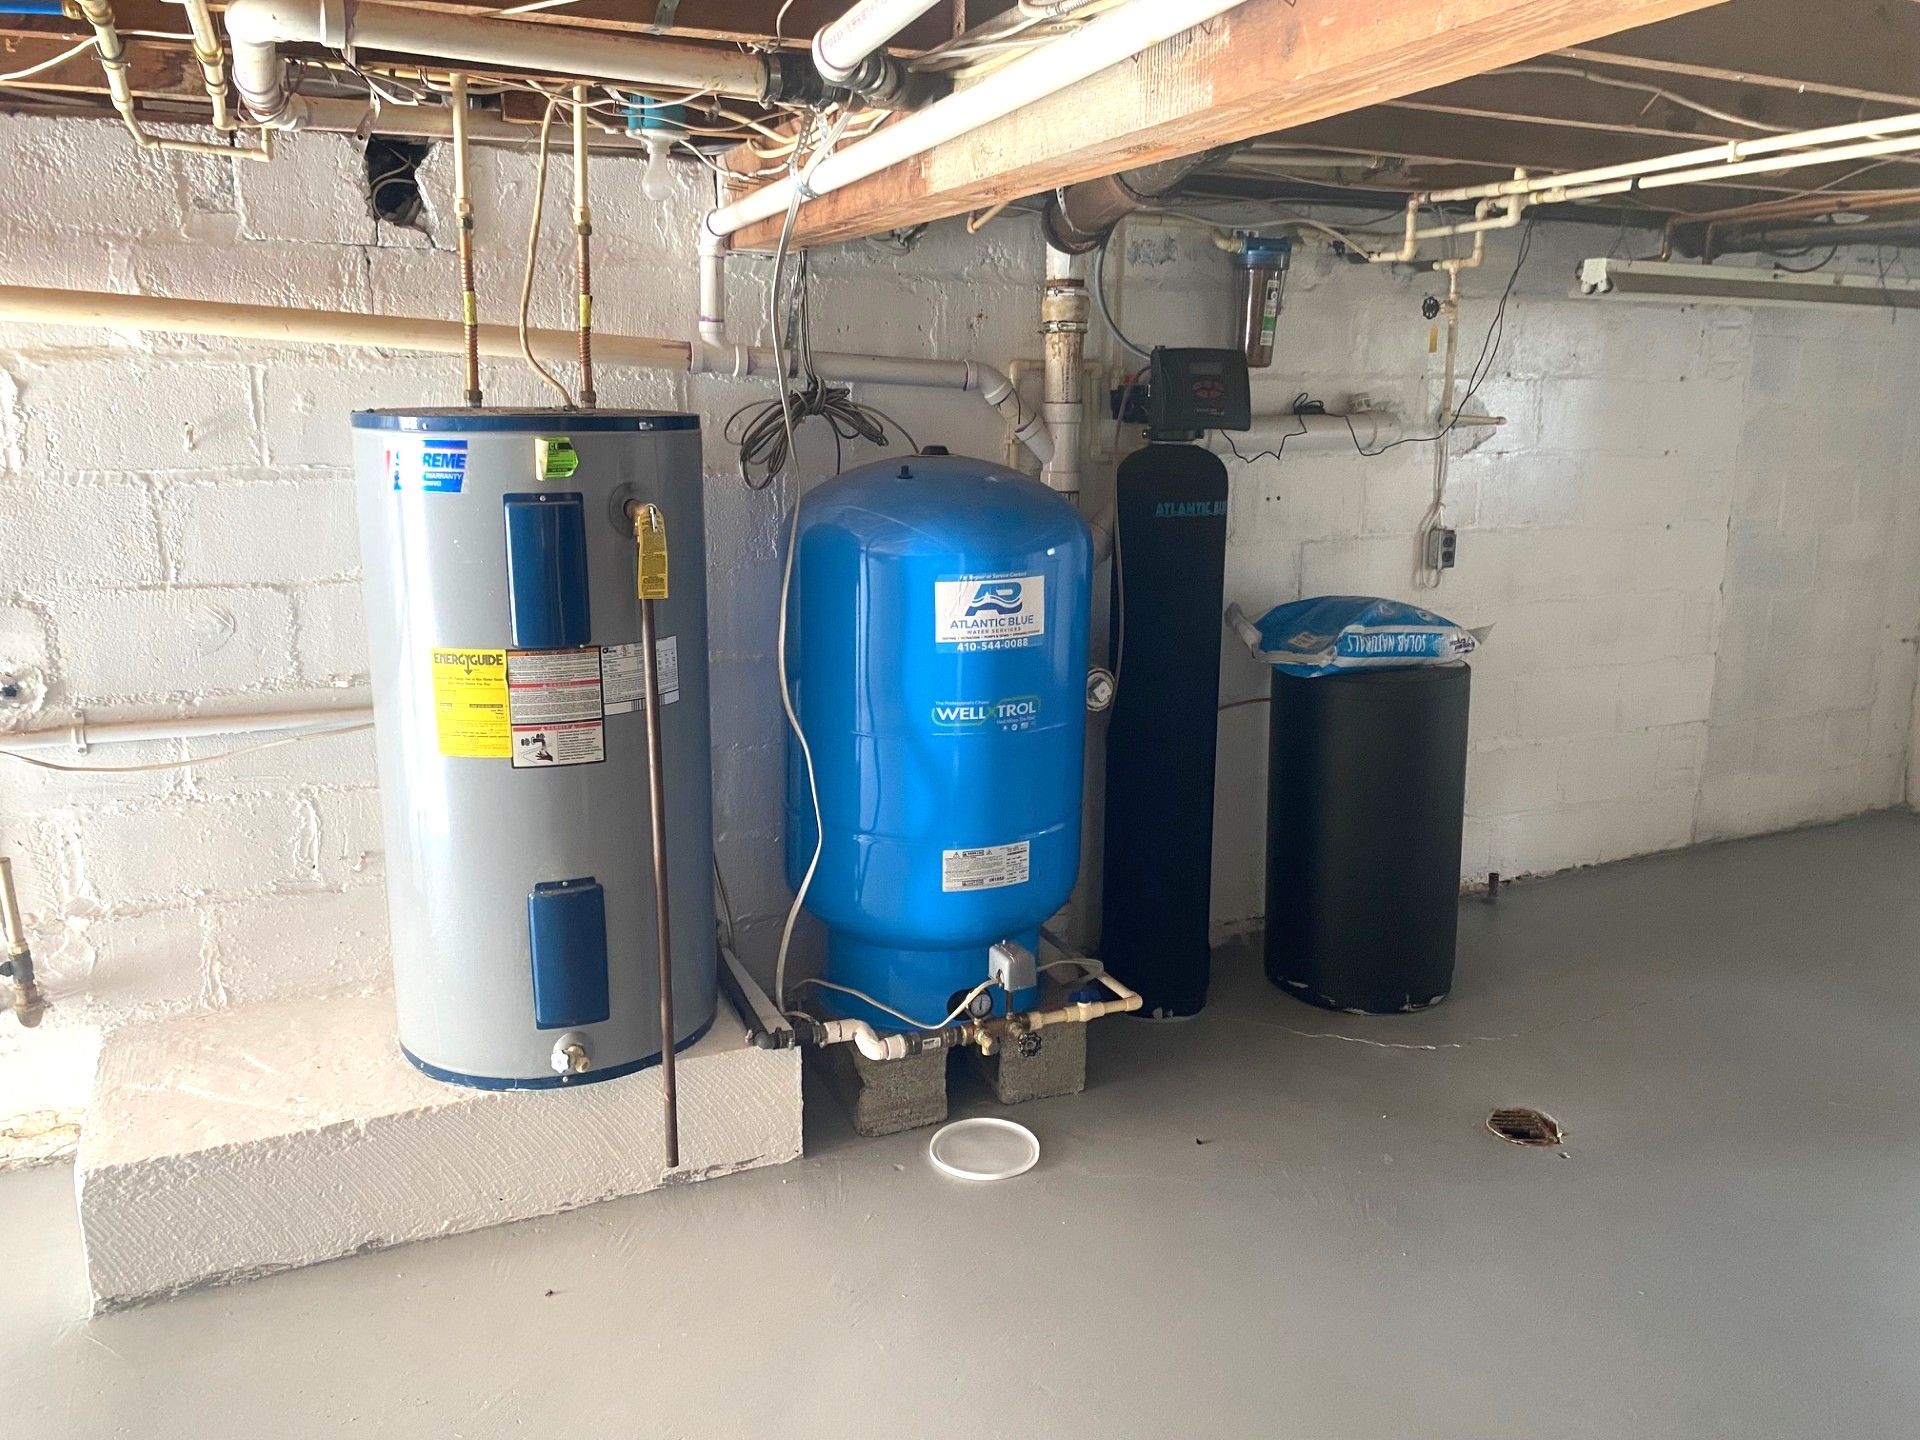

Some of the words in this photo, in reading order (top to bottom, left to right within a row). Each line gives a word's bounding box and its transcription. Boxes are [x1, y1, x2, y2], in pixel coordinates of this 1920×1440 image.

[950, 618, 1006, 629] ATLANTIC
[1007, 615, 1034, 626] BLUE
[991, 626, 1022, 634] SERVICES
[957, 637, 1029, 652] 410-544-0088
[1347, 633, 1395, 653] NATURALS
[1397, 633, 1426, 653] SOLAR
[936, 706, 986, 720] WELL
[998, 702, 1036, 718] TROL
